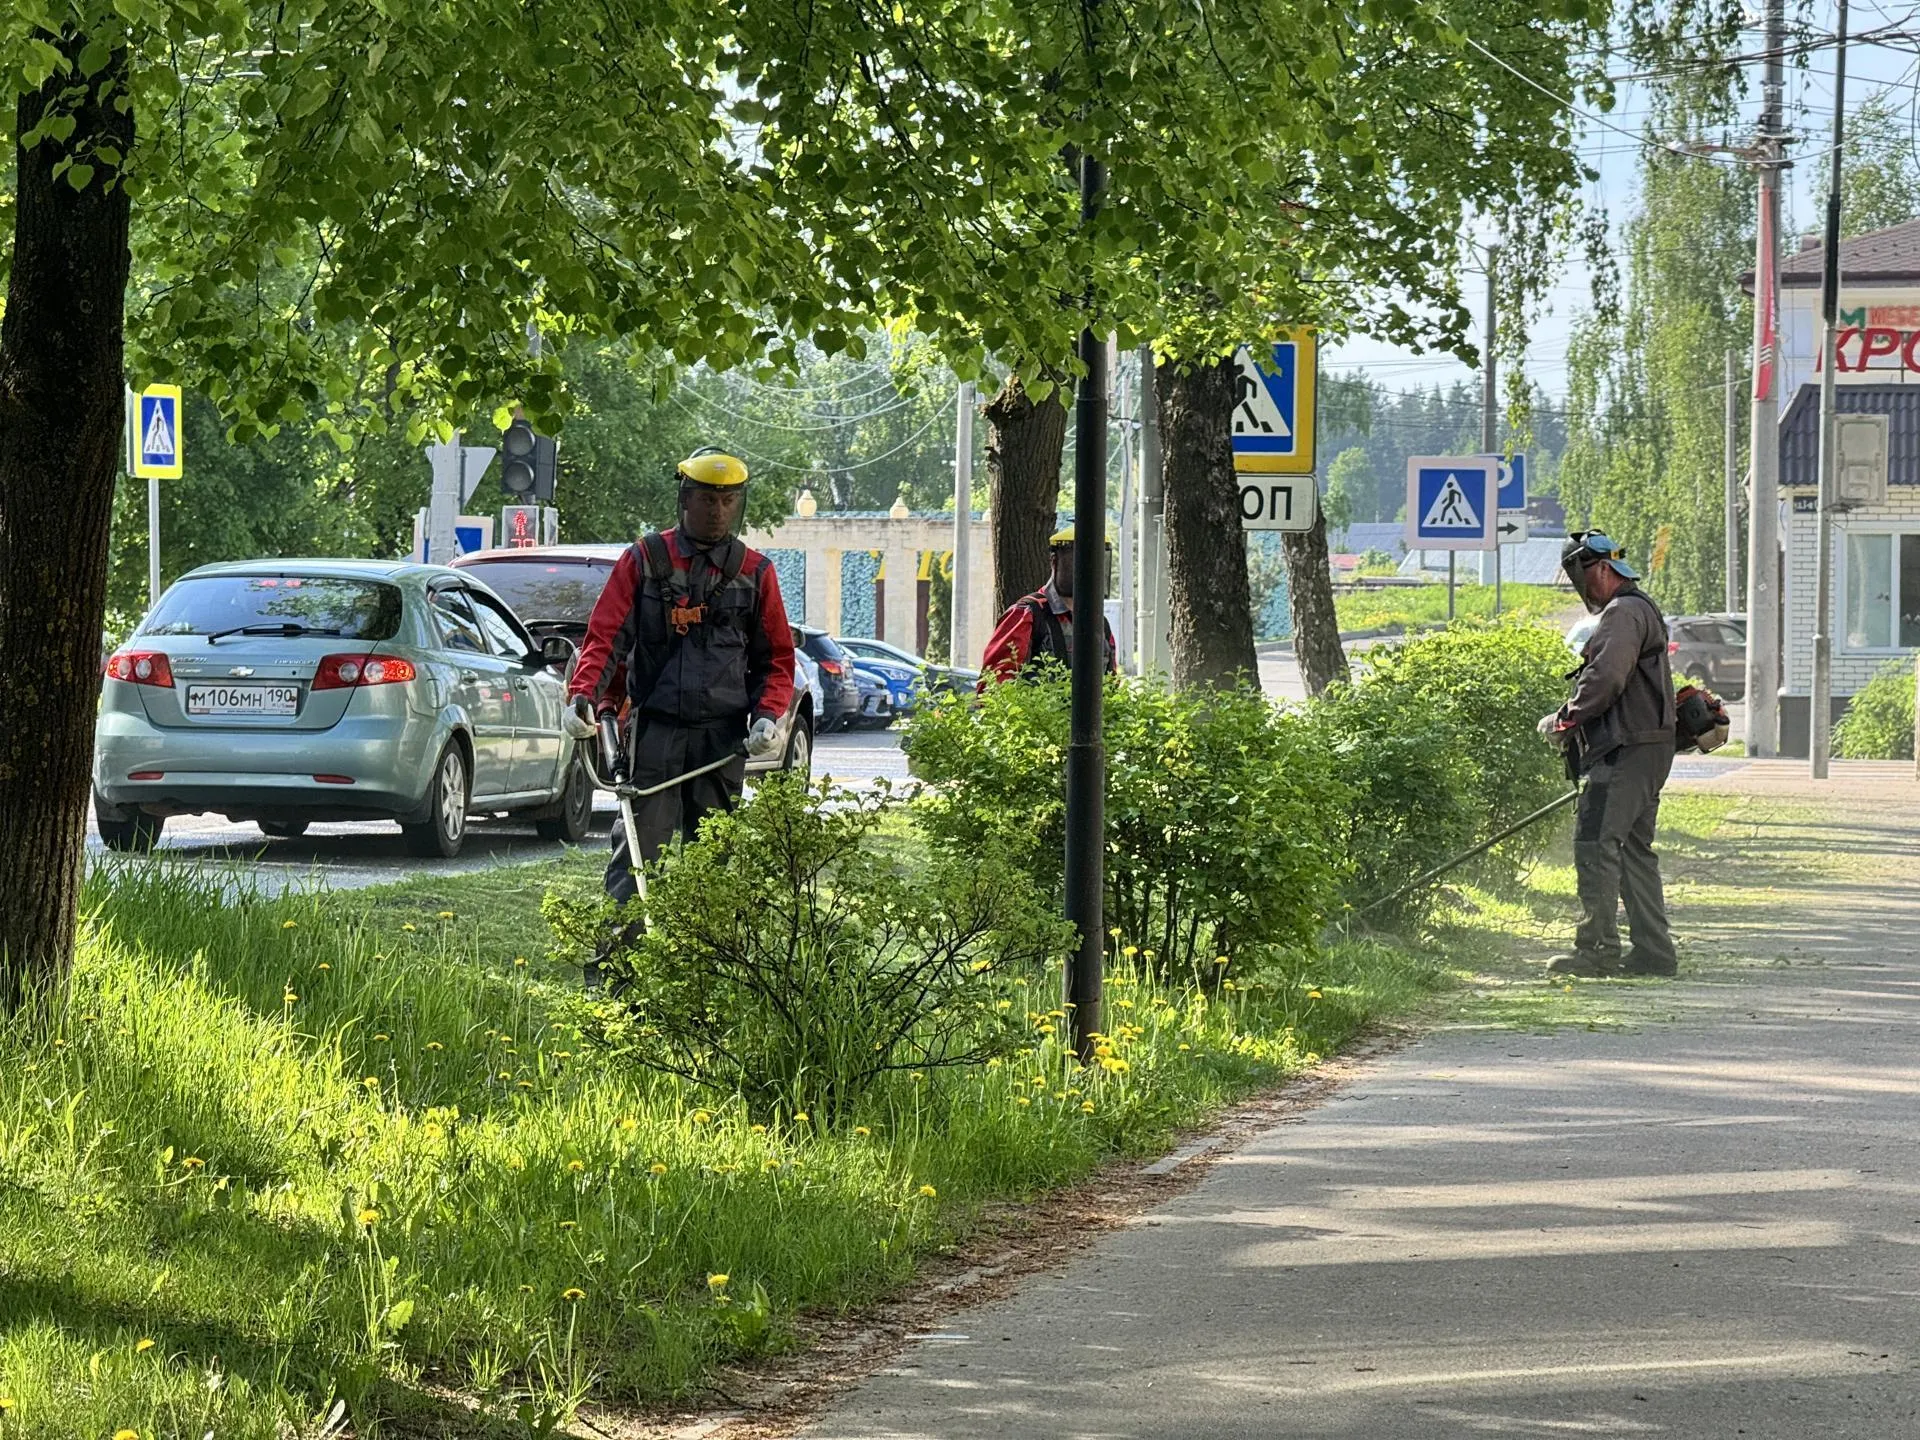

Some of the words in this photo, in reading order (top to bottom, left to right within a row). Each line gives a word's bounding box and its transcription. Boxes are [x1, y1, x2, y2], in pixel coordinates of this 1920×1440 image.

[1239, 485, 1293, 520] ОП
[193, 689, 263, 706] М106МН
[267, 689, 293, 702] 190
